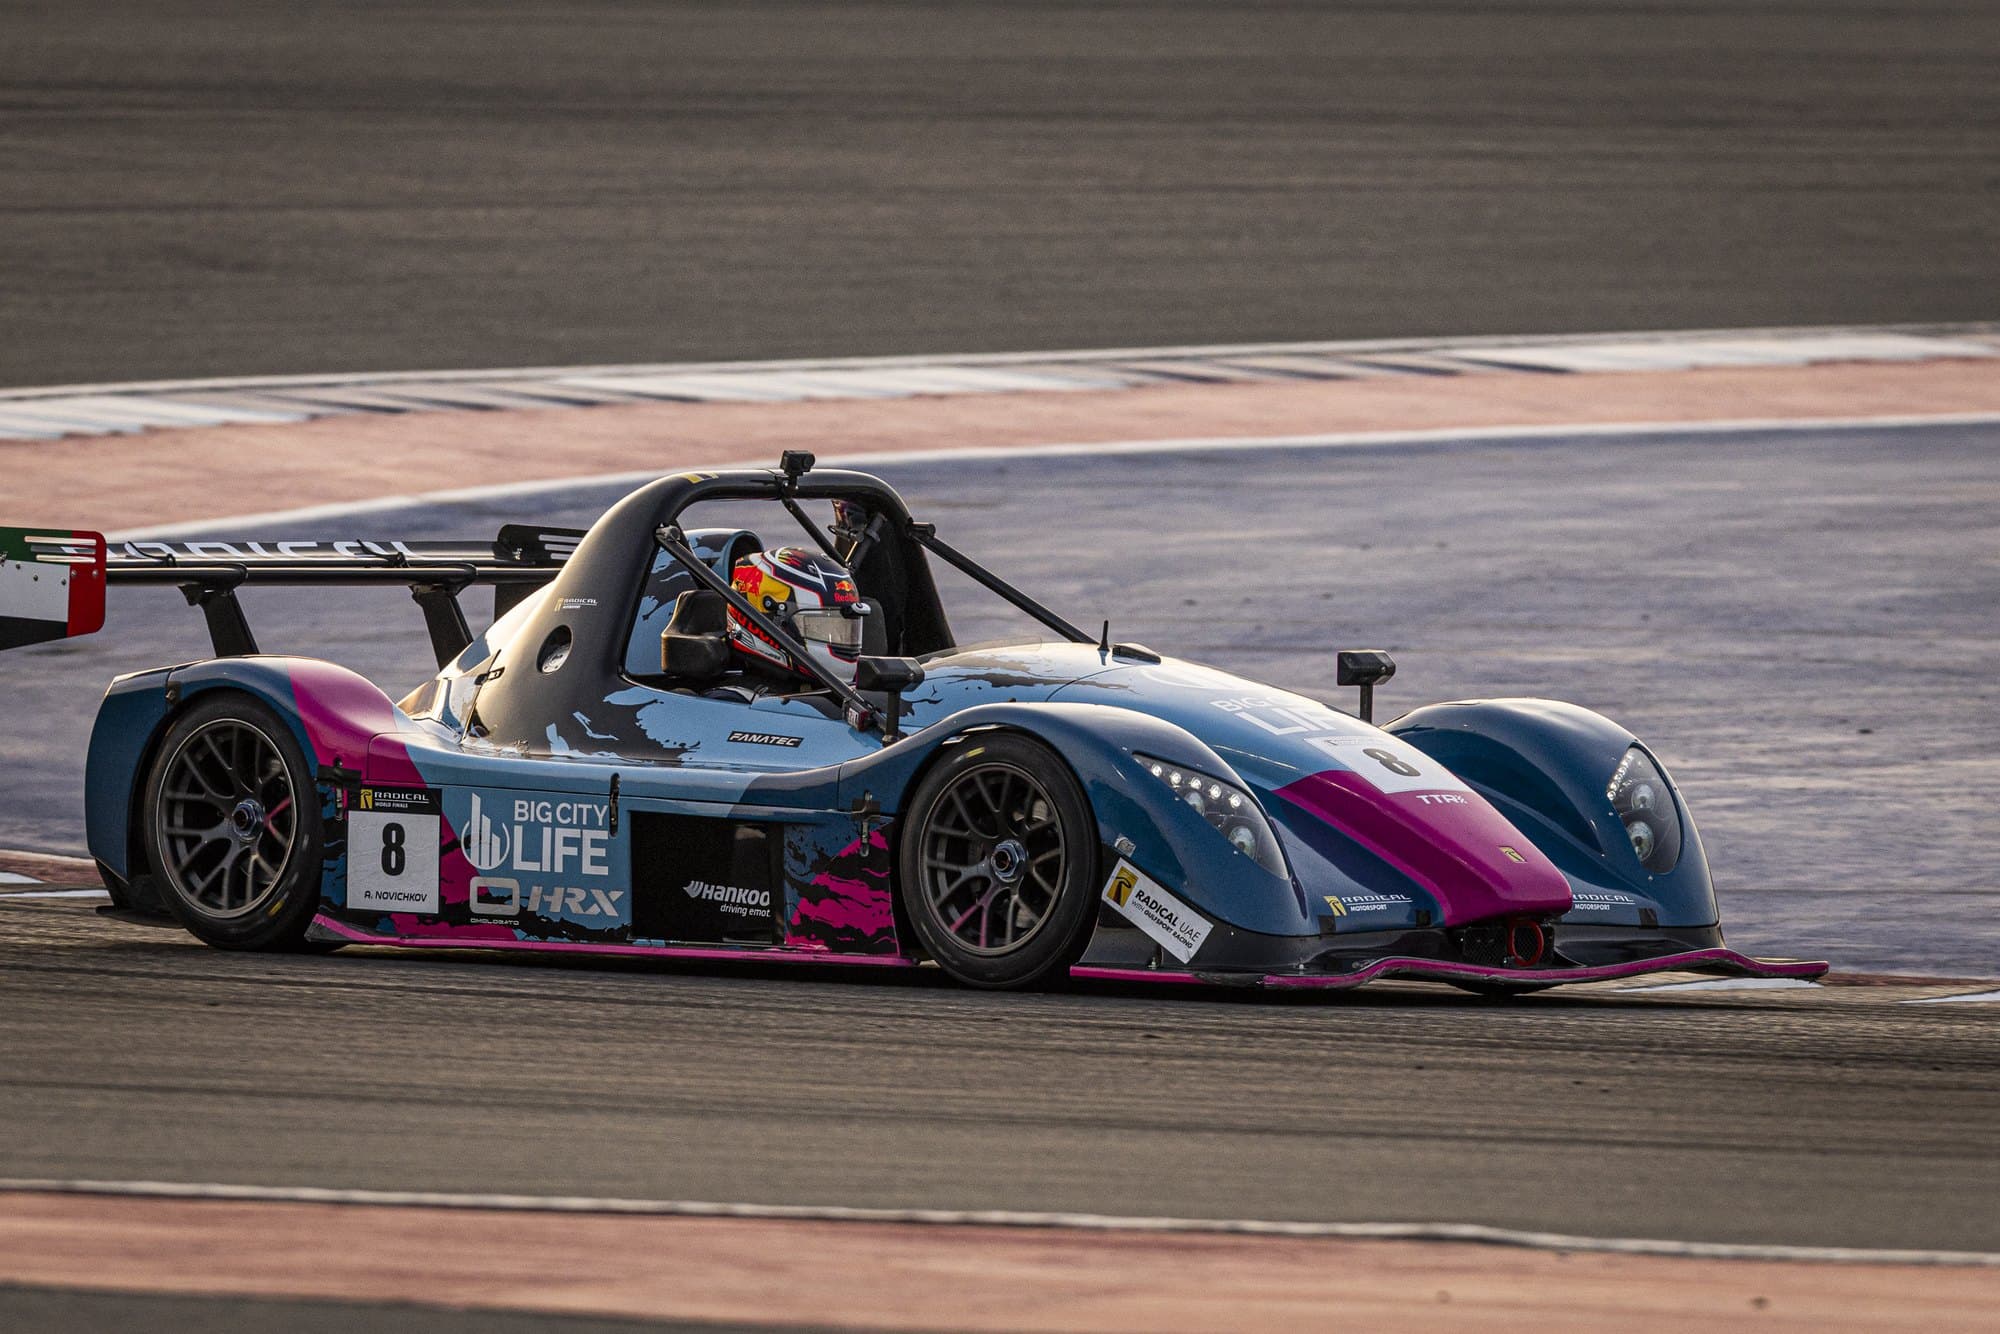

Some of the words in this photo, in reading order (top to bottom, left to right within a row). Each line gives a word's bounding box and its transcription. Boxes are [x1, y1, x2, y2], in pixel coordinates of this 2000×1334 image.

[1234, 707, 1338, 736] LIF
[729, 732, 802, 746] FANATEC
[1363, 748, 1421, 777] 8
[374, 791, 429, 801] RADICAL
[513, 800, 553, 822] BIG
[556, 804, 609, 826] CITY
[381, 822, 406, 876] 8
[512, 825, 609, 875] LIFE
[363, 890, 373, 899] A.
[375, 890, 428, 902] NOVICHKOV
[527, 886, 624, 917] HRX
[701, 884, 770, 906] Hankoo
[1341, 894, 1411, 903] RADICAL
[1350, 904, 1388, 912] MOTORSPORT
[720, 904, 748, 917] driving
[748, 908, 771, 917] emot
[1134, 889, 1179, 927] RADICAL
[1179, 921, 1202, 943] UAE
[1131, 900, 1145, 913] WITH
[1173, 930, 1194, 949] RACING
